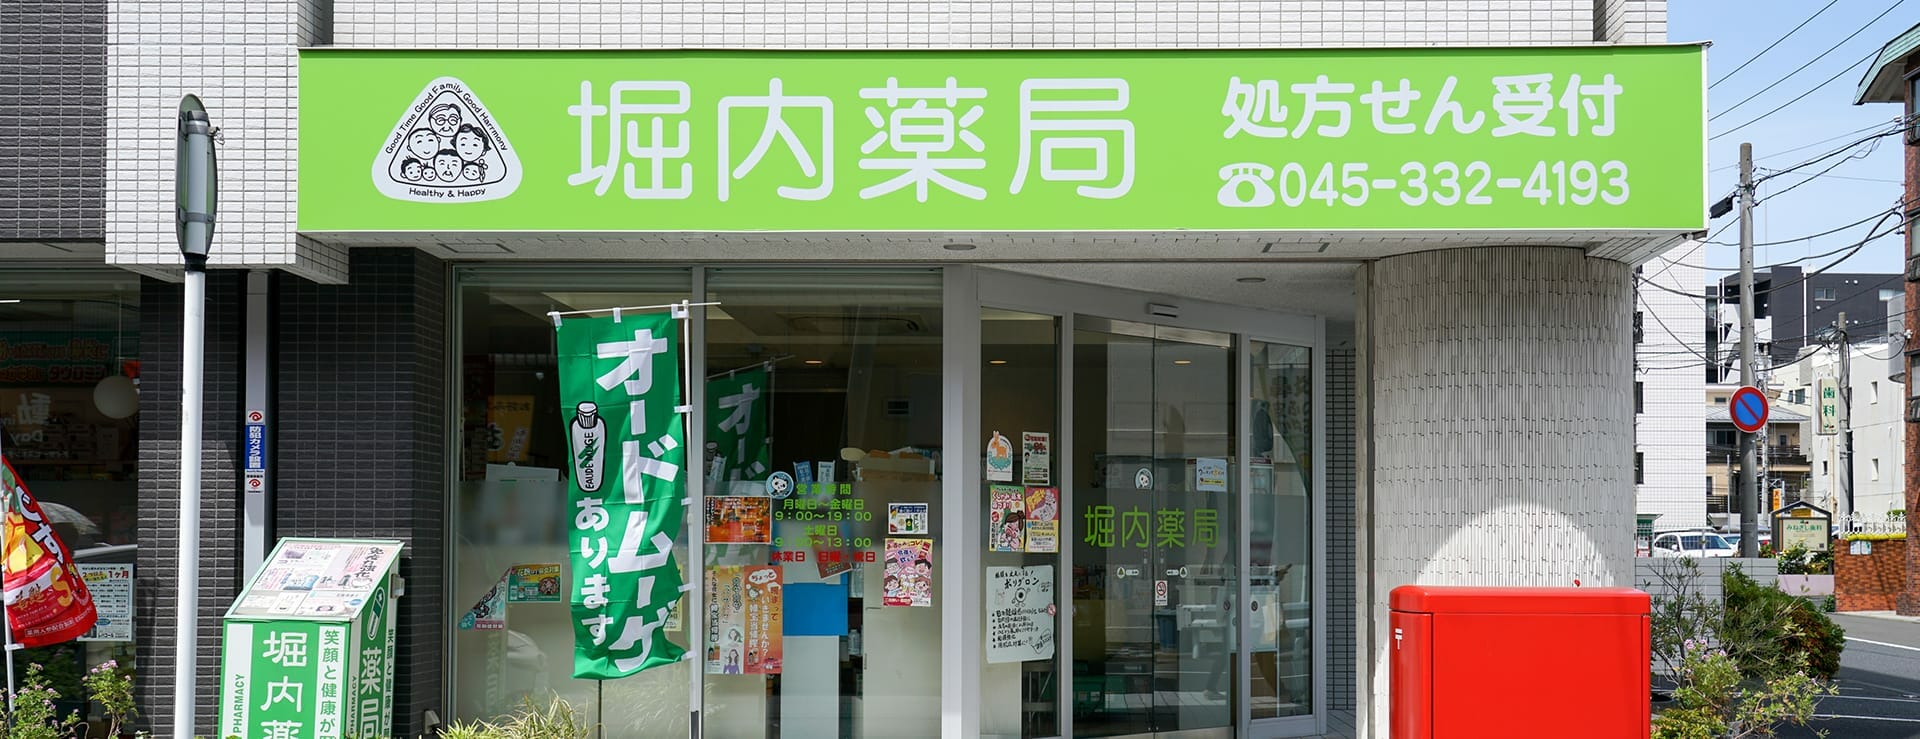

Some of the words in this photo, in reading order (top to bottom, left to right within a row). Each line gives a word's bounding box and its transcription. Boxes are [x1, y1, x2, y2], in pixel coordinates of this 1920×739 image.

[385, 132, 402, 154] Good
[399, 114, 417, 131] Time
[414, 92, 434, 113] Good
[432, 83, 463, 95] Family
[463, 93, 483, 113] Good
[1221, 73, 1624, 139] 処方せん受付
[567, 76, 1136, 203] 堀内薬局
[409, 187, 445, 198] Healthy
[447, 190, 455, 198] &
[457, 187, 486, 198] Happy
[1279, 159, 1630, 208] 045-332-4193
[1823, 387, 1835, 417] 歯科
[596, 328, 679, 673] オードムーゲ
[796, 483, 852, 495] 営業時間
[804, 524, 838, 537] 土曜日
[1083, 504, 1220, 549] 堀内薬局
[575, 497, 614, 646] あります
[771, 551, 806, 562] 休業日
[232, 673, 245, 734] PHARMACY
[319, 629, 340, 739] 笑顔と健康が
